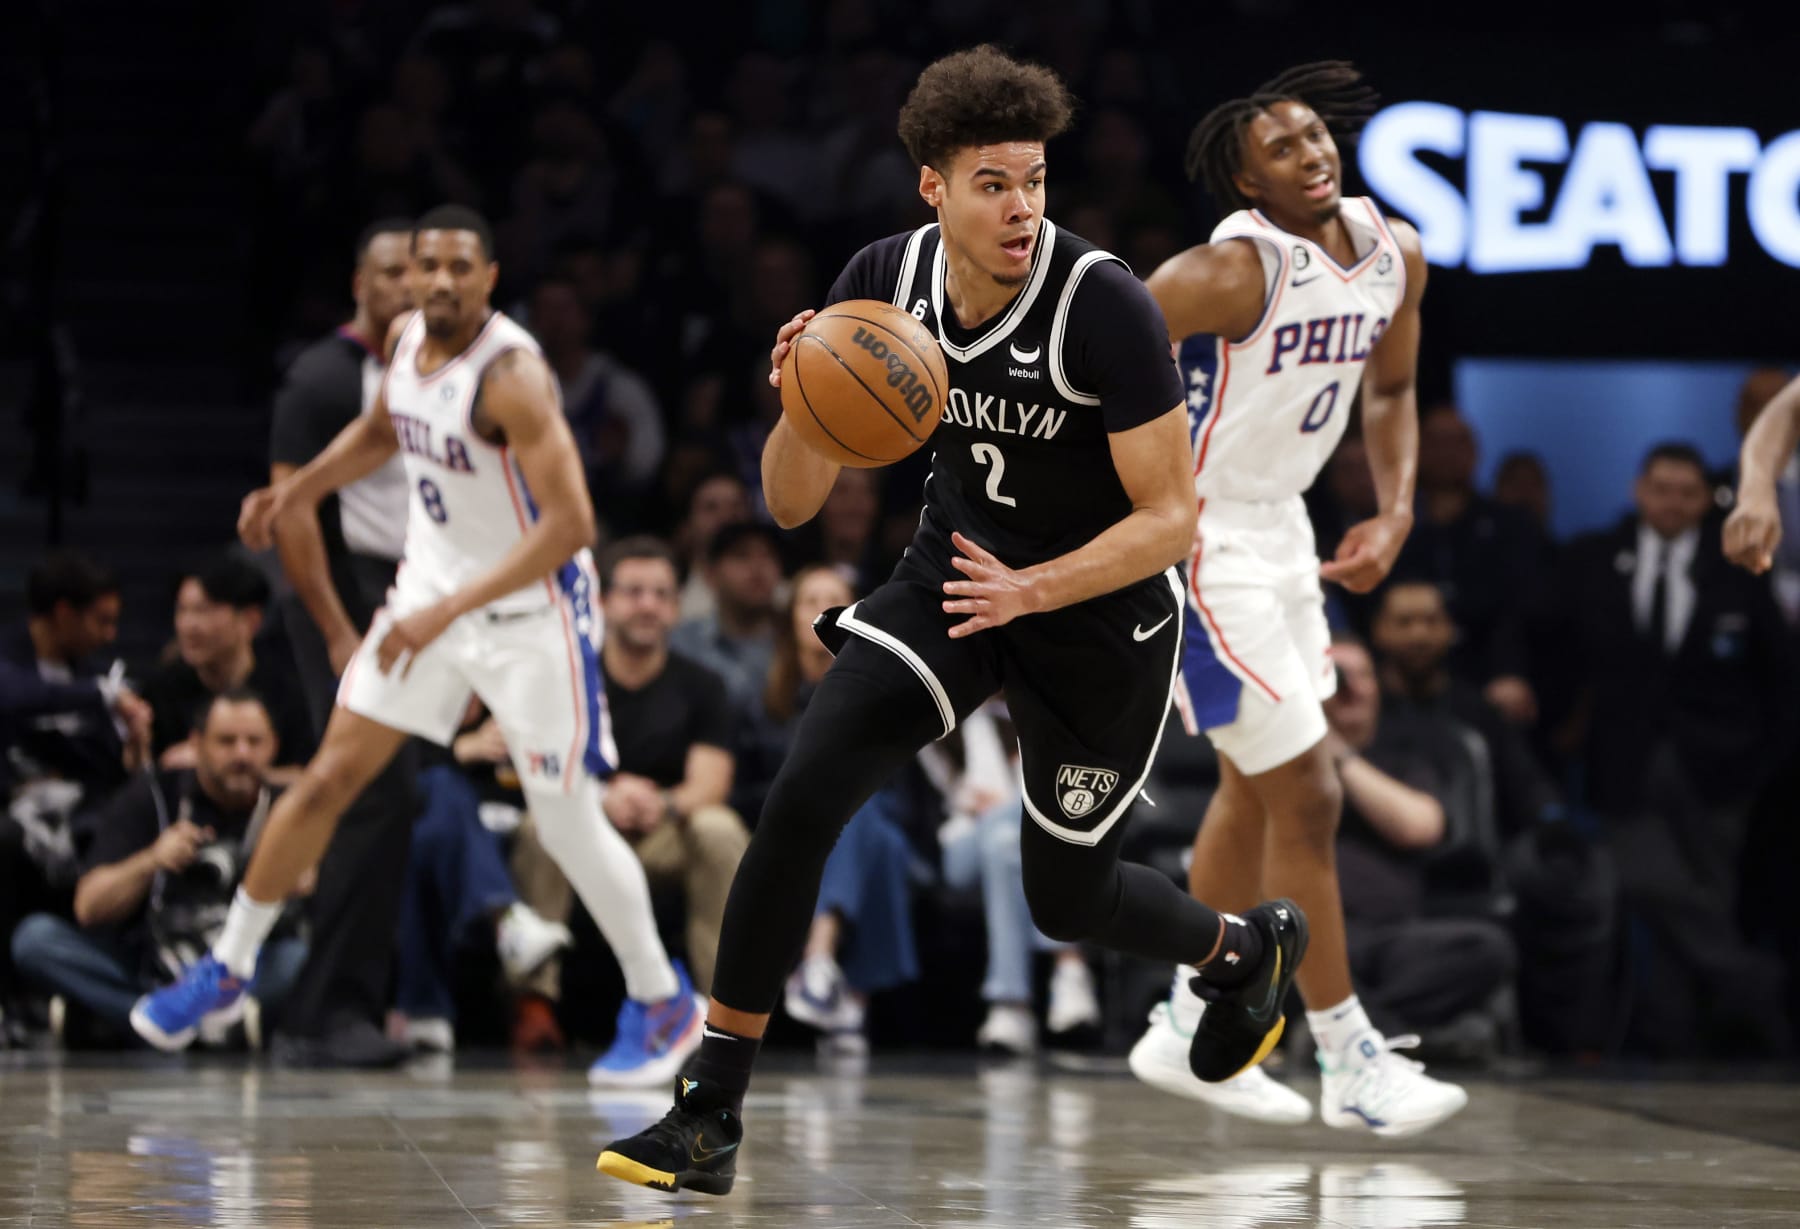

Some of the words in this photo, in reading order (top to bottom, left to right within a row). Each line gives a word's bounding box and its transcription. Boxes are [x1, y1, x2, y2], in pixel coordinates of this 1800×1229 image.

[911, 298, 928, 320] 6
[852, 326, 933, 423] Wilson
[1008, 366, 1040, 380] Webull
[1299, 381, 1340, 434] 0
[391, 413, 476, 474] HILA
[971, 443, 1016, 507] 2
[419, 478, 447, 523] 8
[1060, 768, 1115, 793] NETS
[1071, 793, 1086, 811] B
